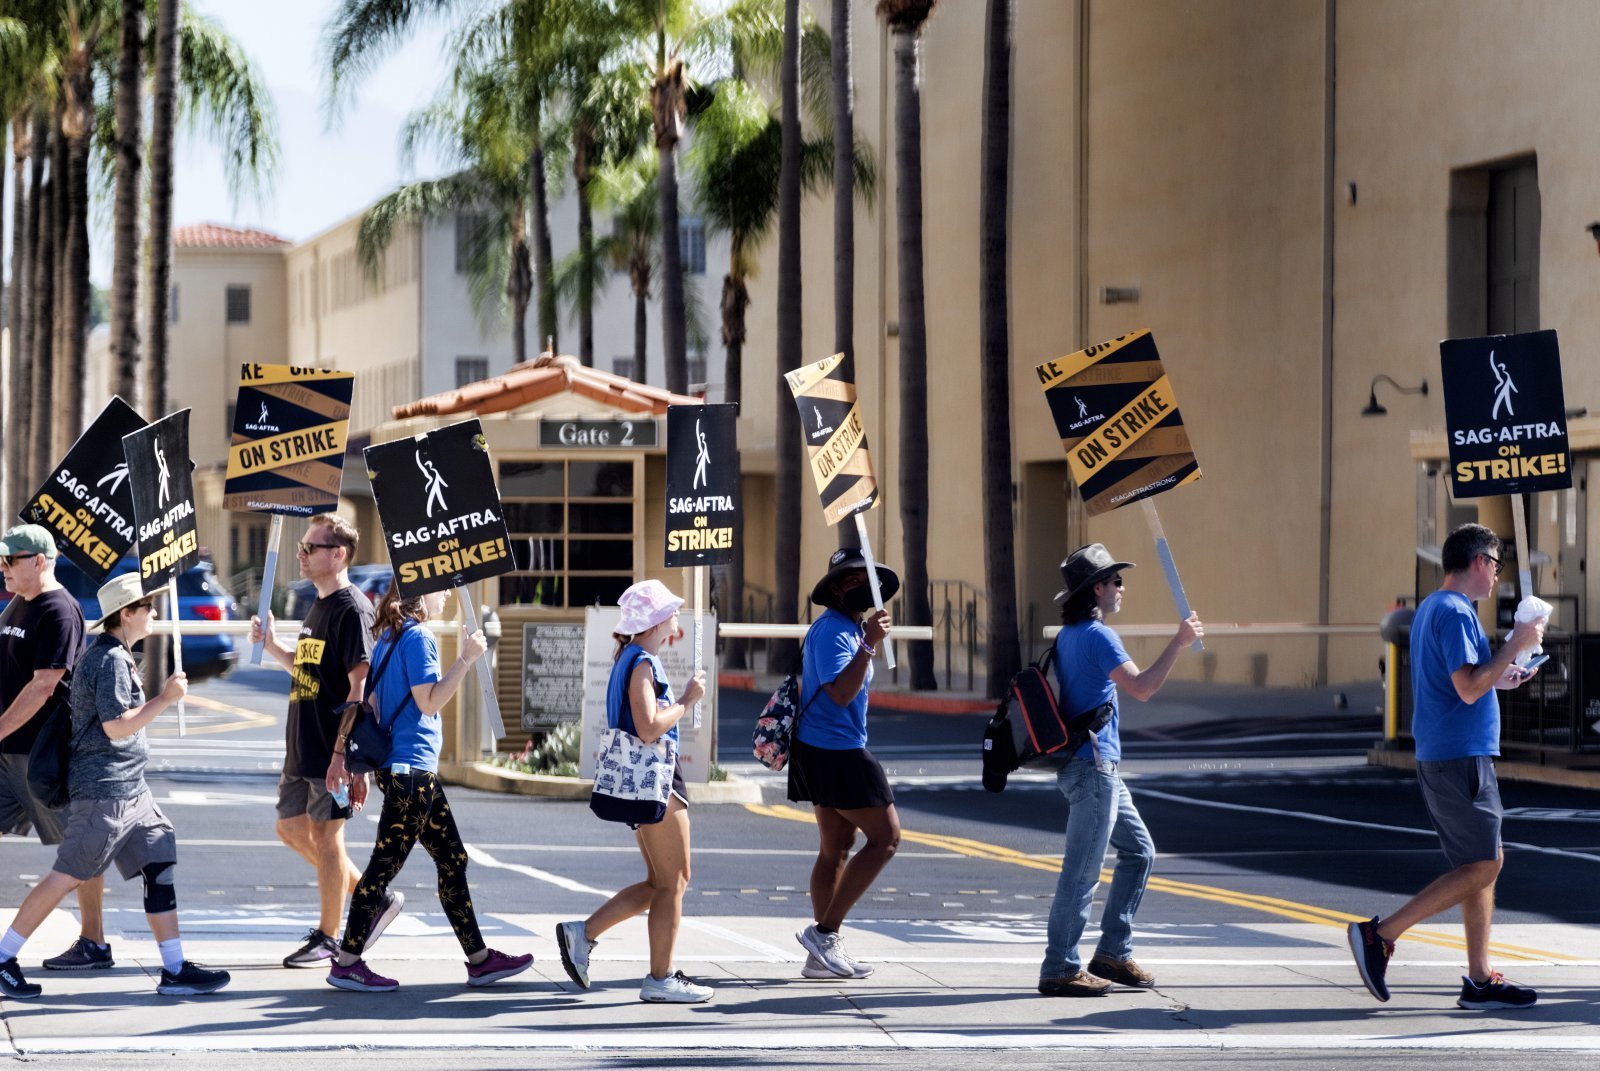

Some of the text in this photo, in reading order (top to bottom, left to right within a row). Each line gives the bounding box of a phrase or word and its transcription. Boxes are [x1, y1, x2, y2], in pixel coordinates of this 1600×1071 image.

[558, 421, 635, 447] Gate 2
[1077, 389, 1169, 469] ON STRIKE
[239, 428, 338, 469] ON STRIKE
[817, 450, 836, 479] ON
[832, 412, 862, 462] STRIKE
[1498, 444, 1521, 457] ON
[1456, 452, 1567, 483] STRIKE!
[75, 508, 95, 527] ON
[246, 500, 313, 514] #SAGAFTRASTRONG
[38, 493, 119, 570] STRIKE!
[694, 516, 707, 528] ON
[163, 529, 174, 544] ON
[438, 537, 460, 553] ON
[668, 527, 733, 552] STRIKE!
[142, 529, 197, 579] STRIKE!
[399, 537, 508, 583] STRIKE!
